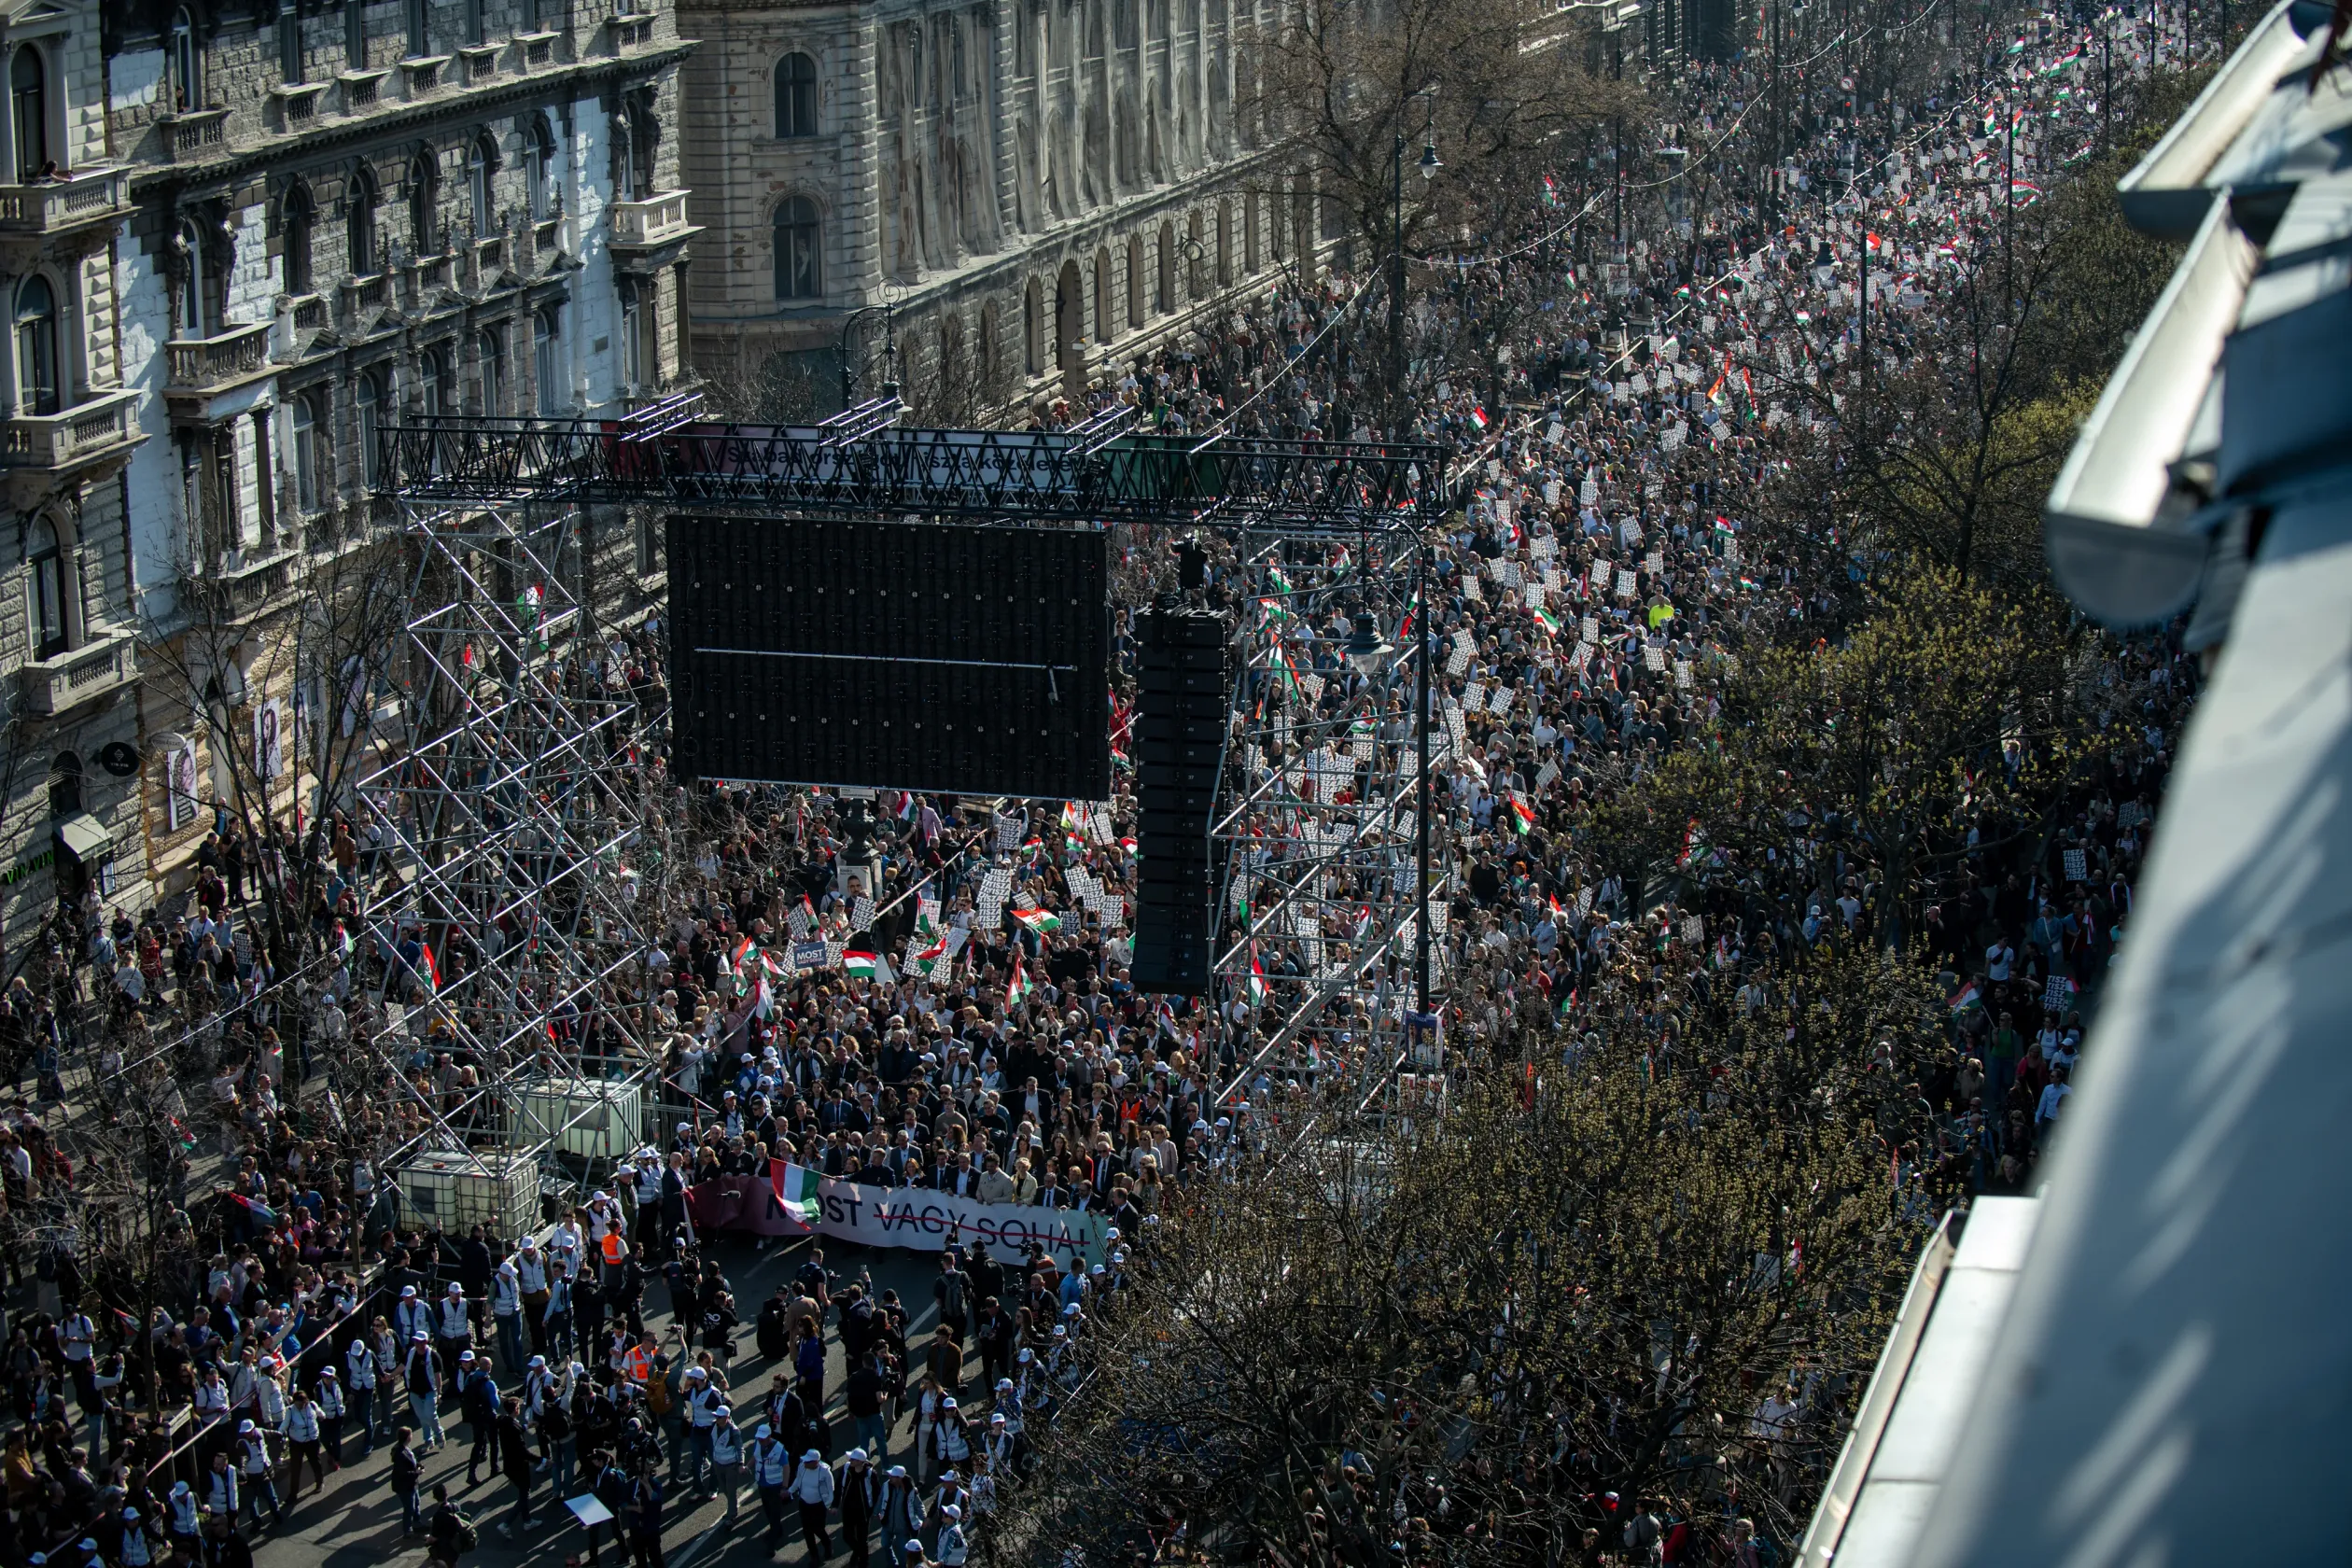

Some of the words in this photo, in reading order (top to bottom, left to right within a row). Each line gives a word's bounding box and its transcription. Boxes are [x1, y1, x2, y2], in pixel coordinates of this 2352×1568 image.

[1064, 866, 1086, 875] TISZA
[1066, 872, 1089, 881] TISZA
[1083, 877, 1103, 886] TISZA
[1083, 884, 1103, 892] TISZA
[1083, 890, 1104, 899] TISZA
[856, 897, 876, 907] TISZA
[854, 903, 875, 913] TISZA
[853, 909, 875, 918] TISZA
[850, 915, 873, 925] TISZA
[908, 941, 931, 950] TISZA
[797, 949, 823, 960] MOST
[875, 1203, 966, 1234] VAGY
